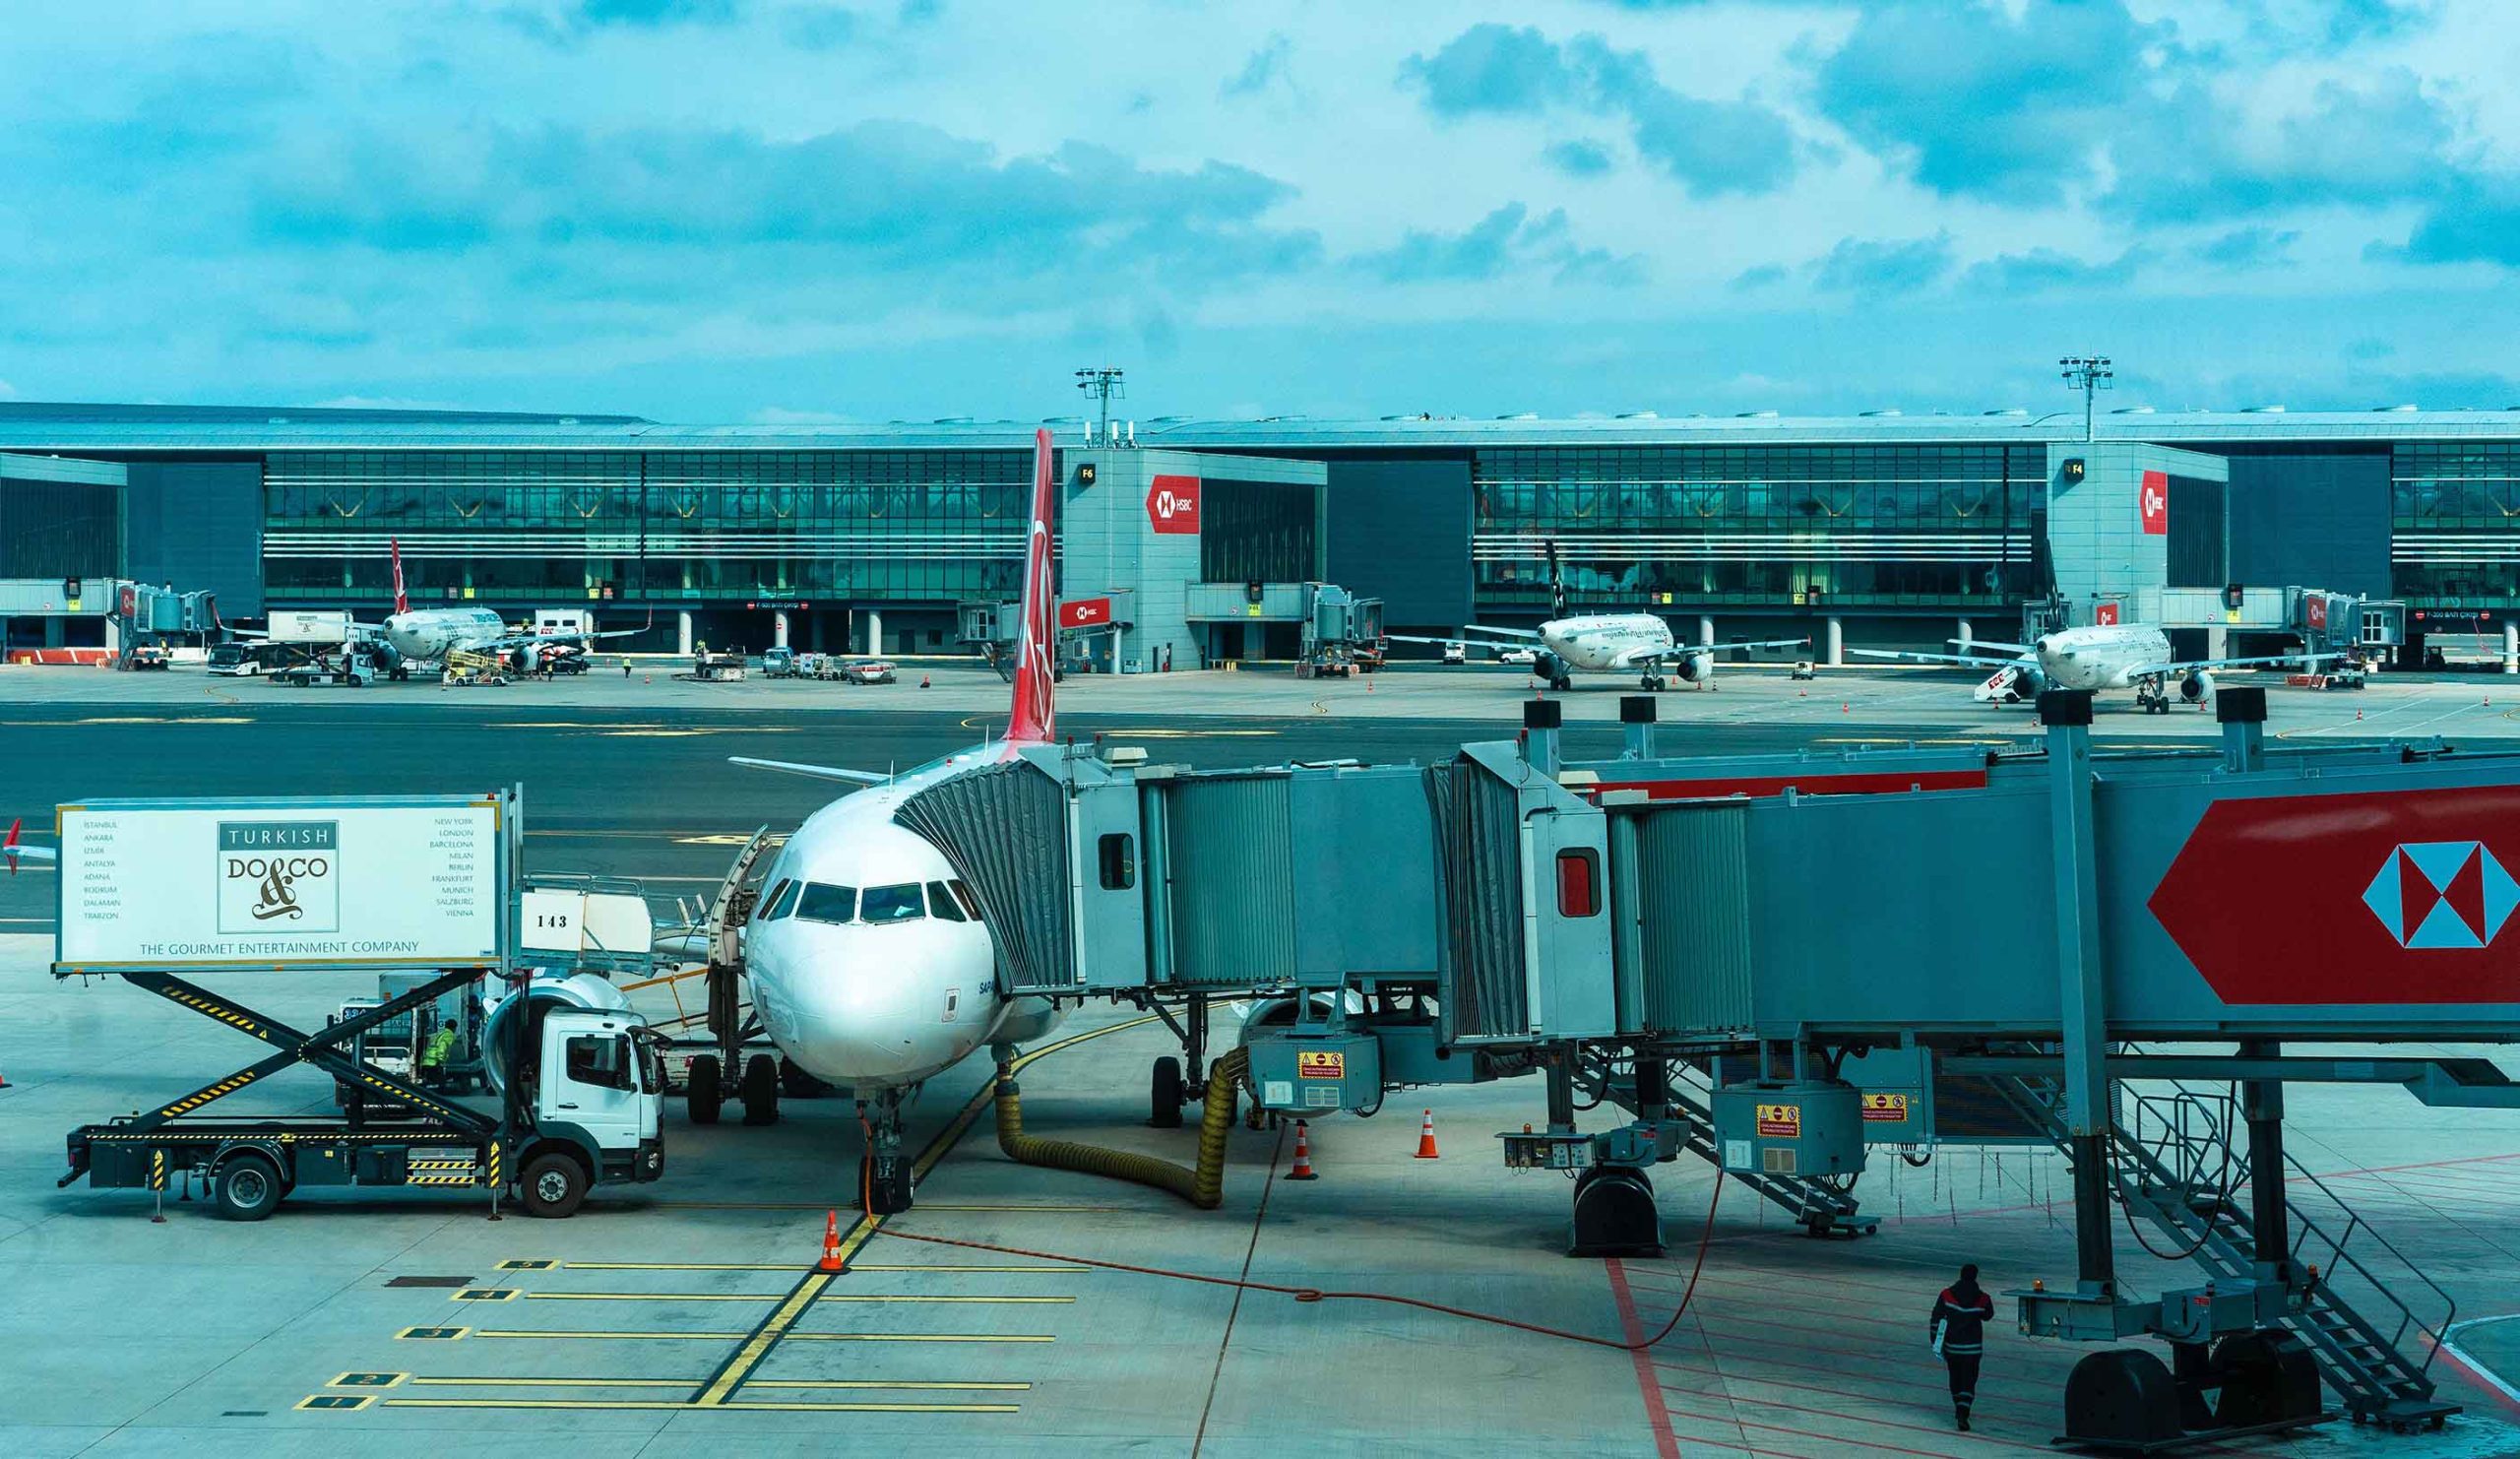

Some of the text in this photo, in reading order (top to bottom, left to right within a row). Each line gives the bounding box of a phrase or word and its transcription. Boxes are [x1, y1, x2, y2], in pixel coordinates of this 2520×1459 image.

[1082, 469, 1094, 478] F6
[2072, 464, 2083, 475] F4
[1175, 498, 1192, 511] HSBC
[228, 829, 328, 844] TURKISH
[140, 941, 419, 955] THE GOURMET ENTERTAINMENT COMPANY
[358, 1374, 378, 1384] 2
[330, 1397, 343, 1407] 1
